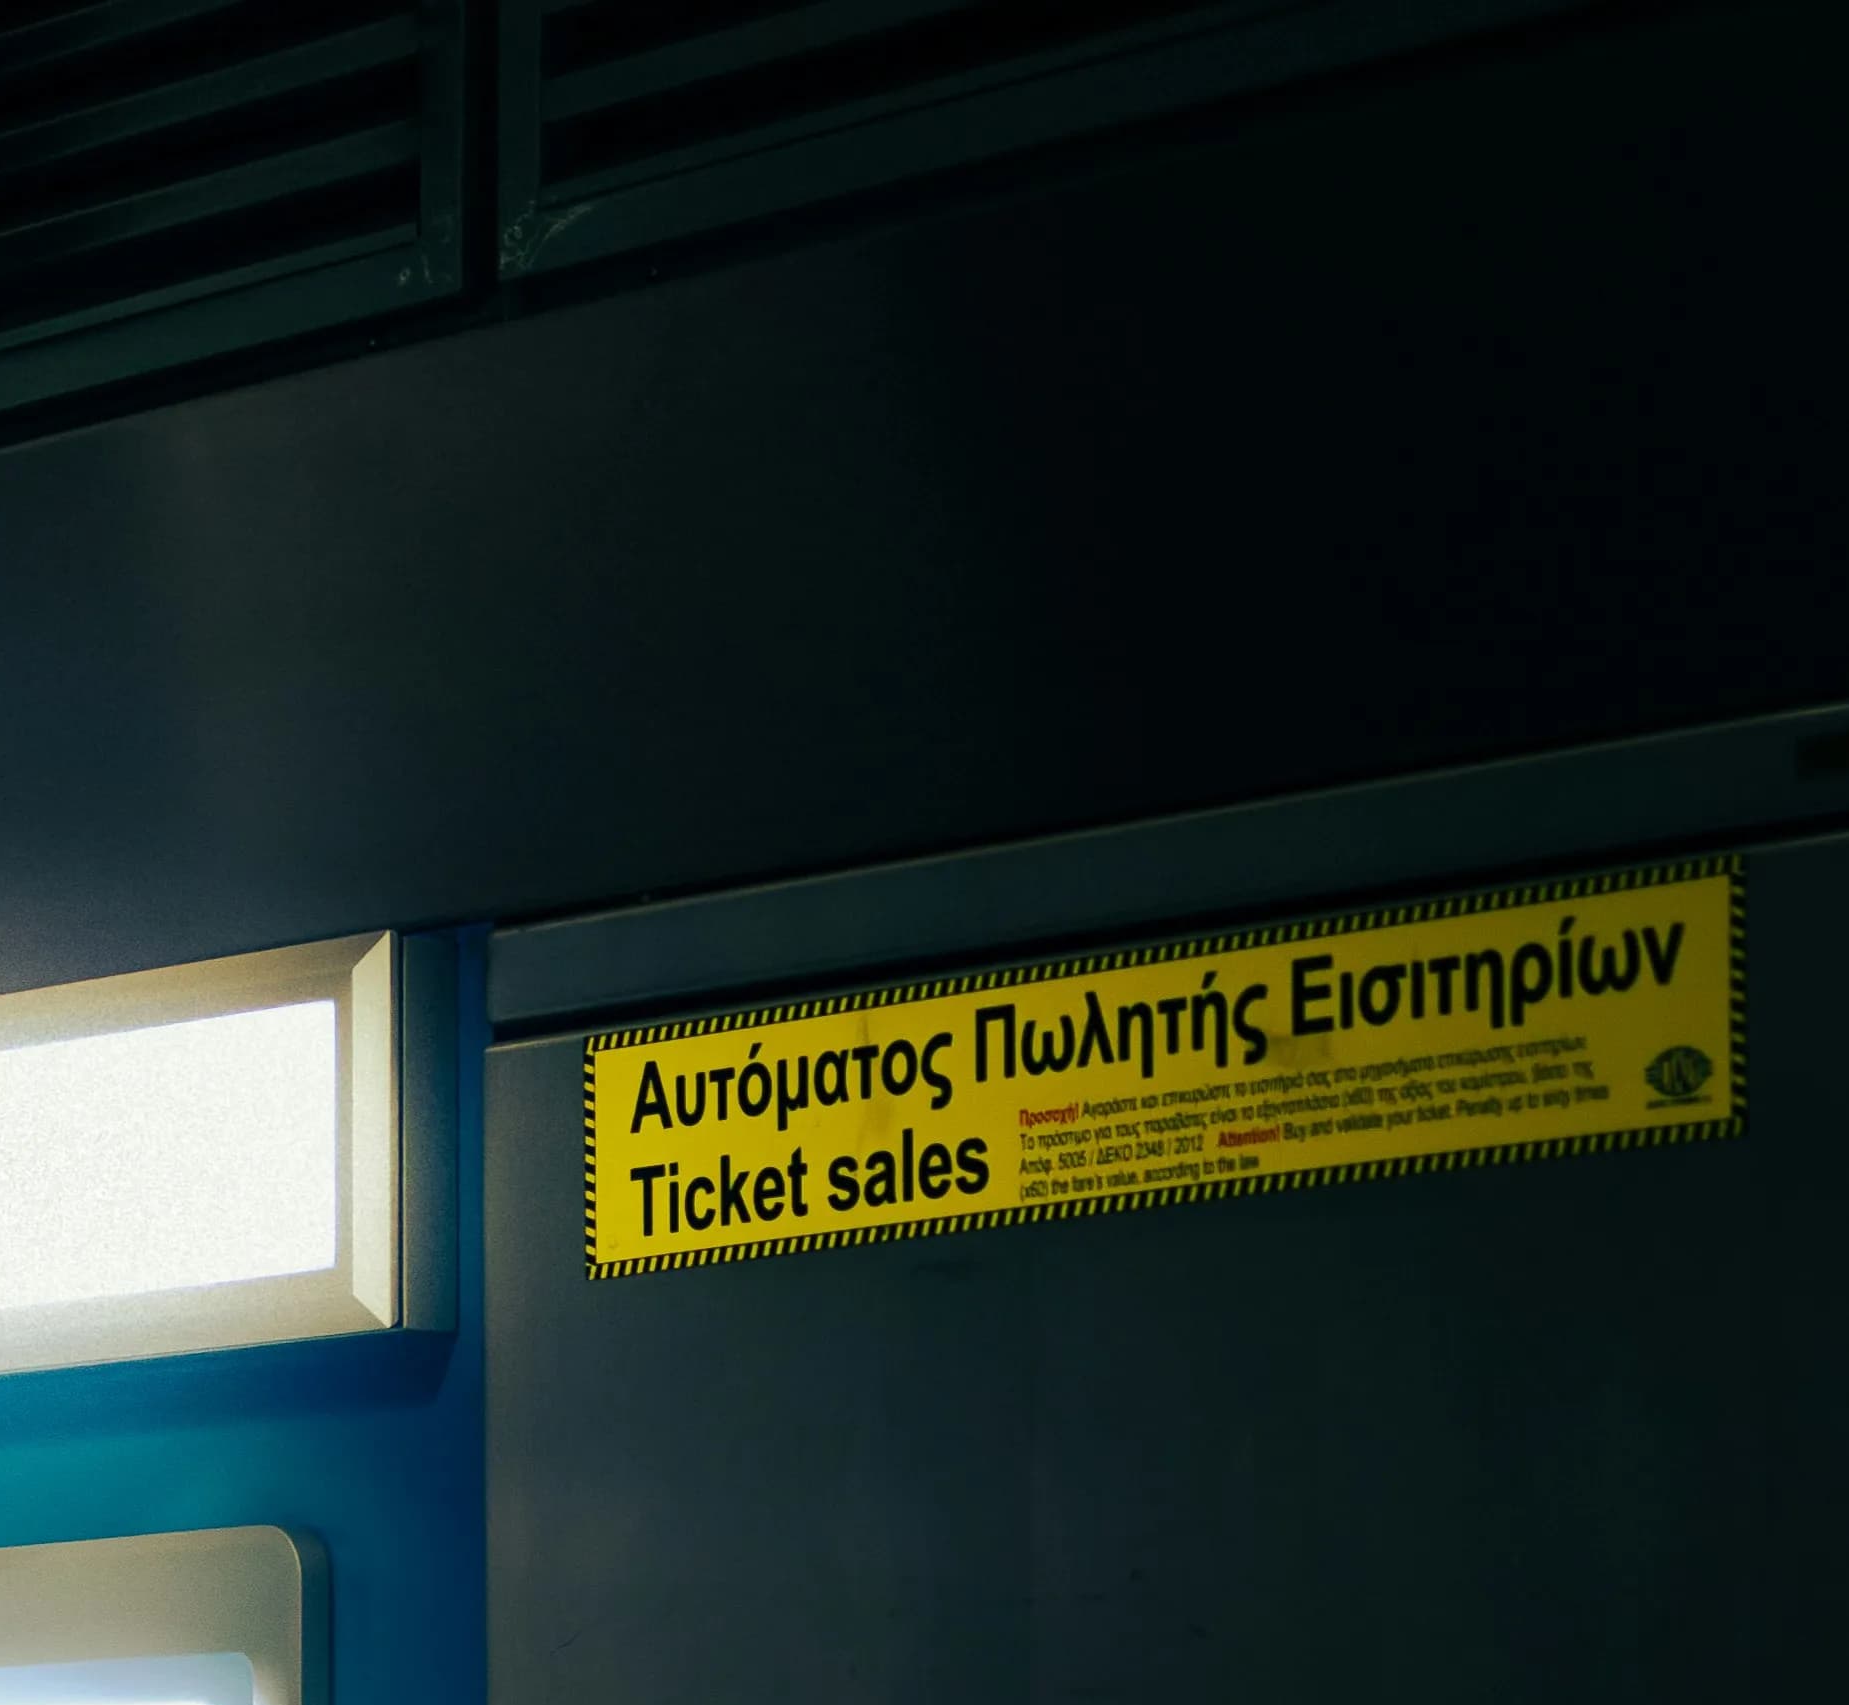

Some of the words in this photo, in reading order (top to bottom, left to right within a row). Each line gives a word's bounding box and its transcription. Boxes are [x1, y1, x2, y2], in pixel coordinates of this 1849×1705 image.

[630, 1032, 954, 1135] Αυτόματος
[975, 970, 1268, 1082] Πωλητής
[1292, 914, 1686, 1036] Εισιτηρίων
[1019, 1105, 1078, 1127] Προσοχή!
[1019, 1133, 1034, 1150] Το
[1219, 1127, 1279, 1147] Attention!
[1284, 1121, 1305, 1143] Buy
[631, 1148, 808, 1237] Ticket
[828, 1128, 988, 1211] sales
